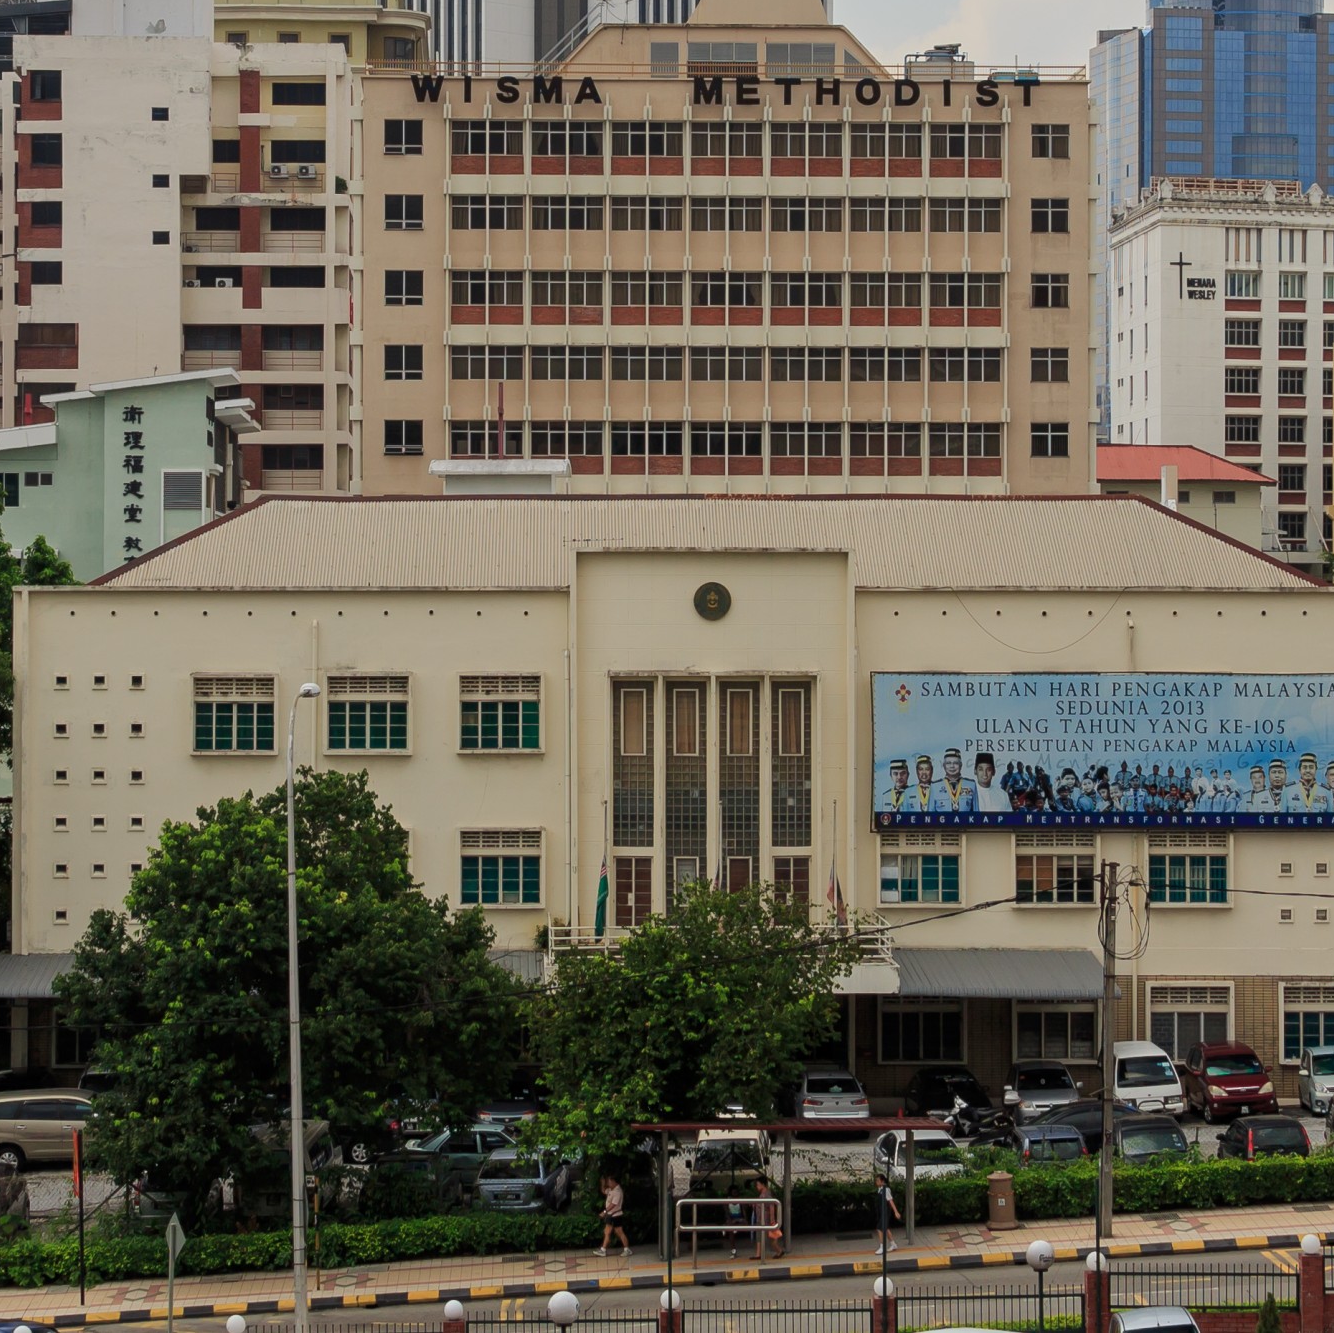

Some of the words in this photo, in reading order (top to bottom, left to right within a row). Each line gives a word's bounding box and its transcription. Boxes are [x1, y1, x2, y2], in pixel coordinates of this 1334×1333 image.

[411, 74, 603, 105] WISMA
[693, 77, 1040, 107] METHODIST
[1186, 277, 1216, 288] MENARA
[1186, 289, 1216, 300] WESLEY
[920, 681, 1038, 698] SAMBUTAN
[1049, 681, 1100, 698] HARI
[1111, 681, 1224, 698] PENGAKAP
[1055, 700, 1150, 716] SEDUNIA
[1160, 700, 1206, 716] 2013
[975, 718, 1049, 735] ULANG
[1059, 718, 1137, 735] TAHUN
[1148, 718, 1209, 735] YANG
[1218, 718, 1286, 735] KE-105
[964, 738, 1095, 753] PERSEKUTUAN
[1103, 738, 1199, 753] PENGAKAP
[1206, 738, 1298, 754] MALAYSIA
